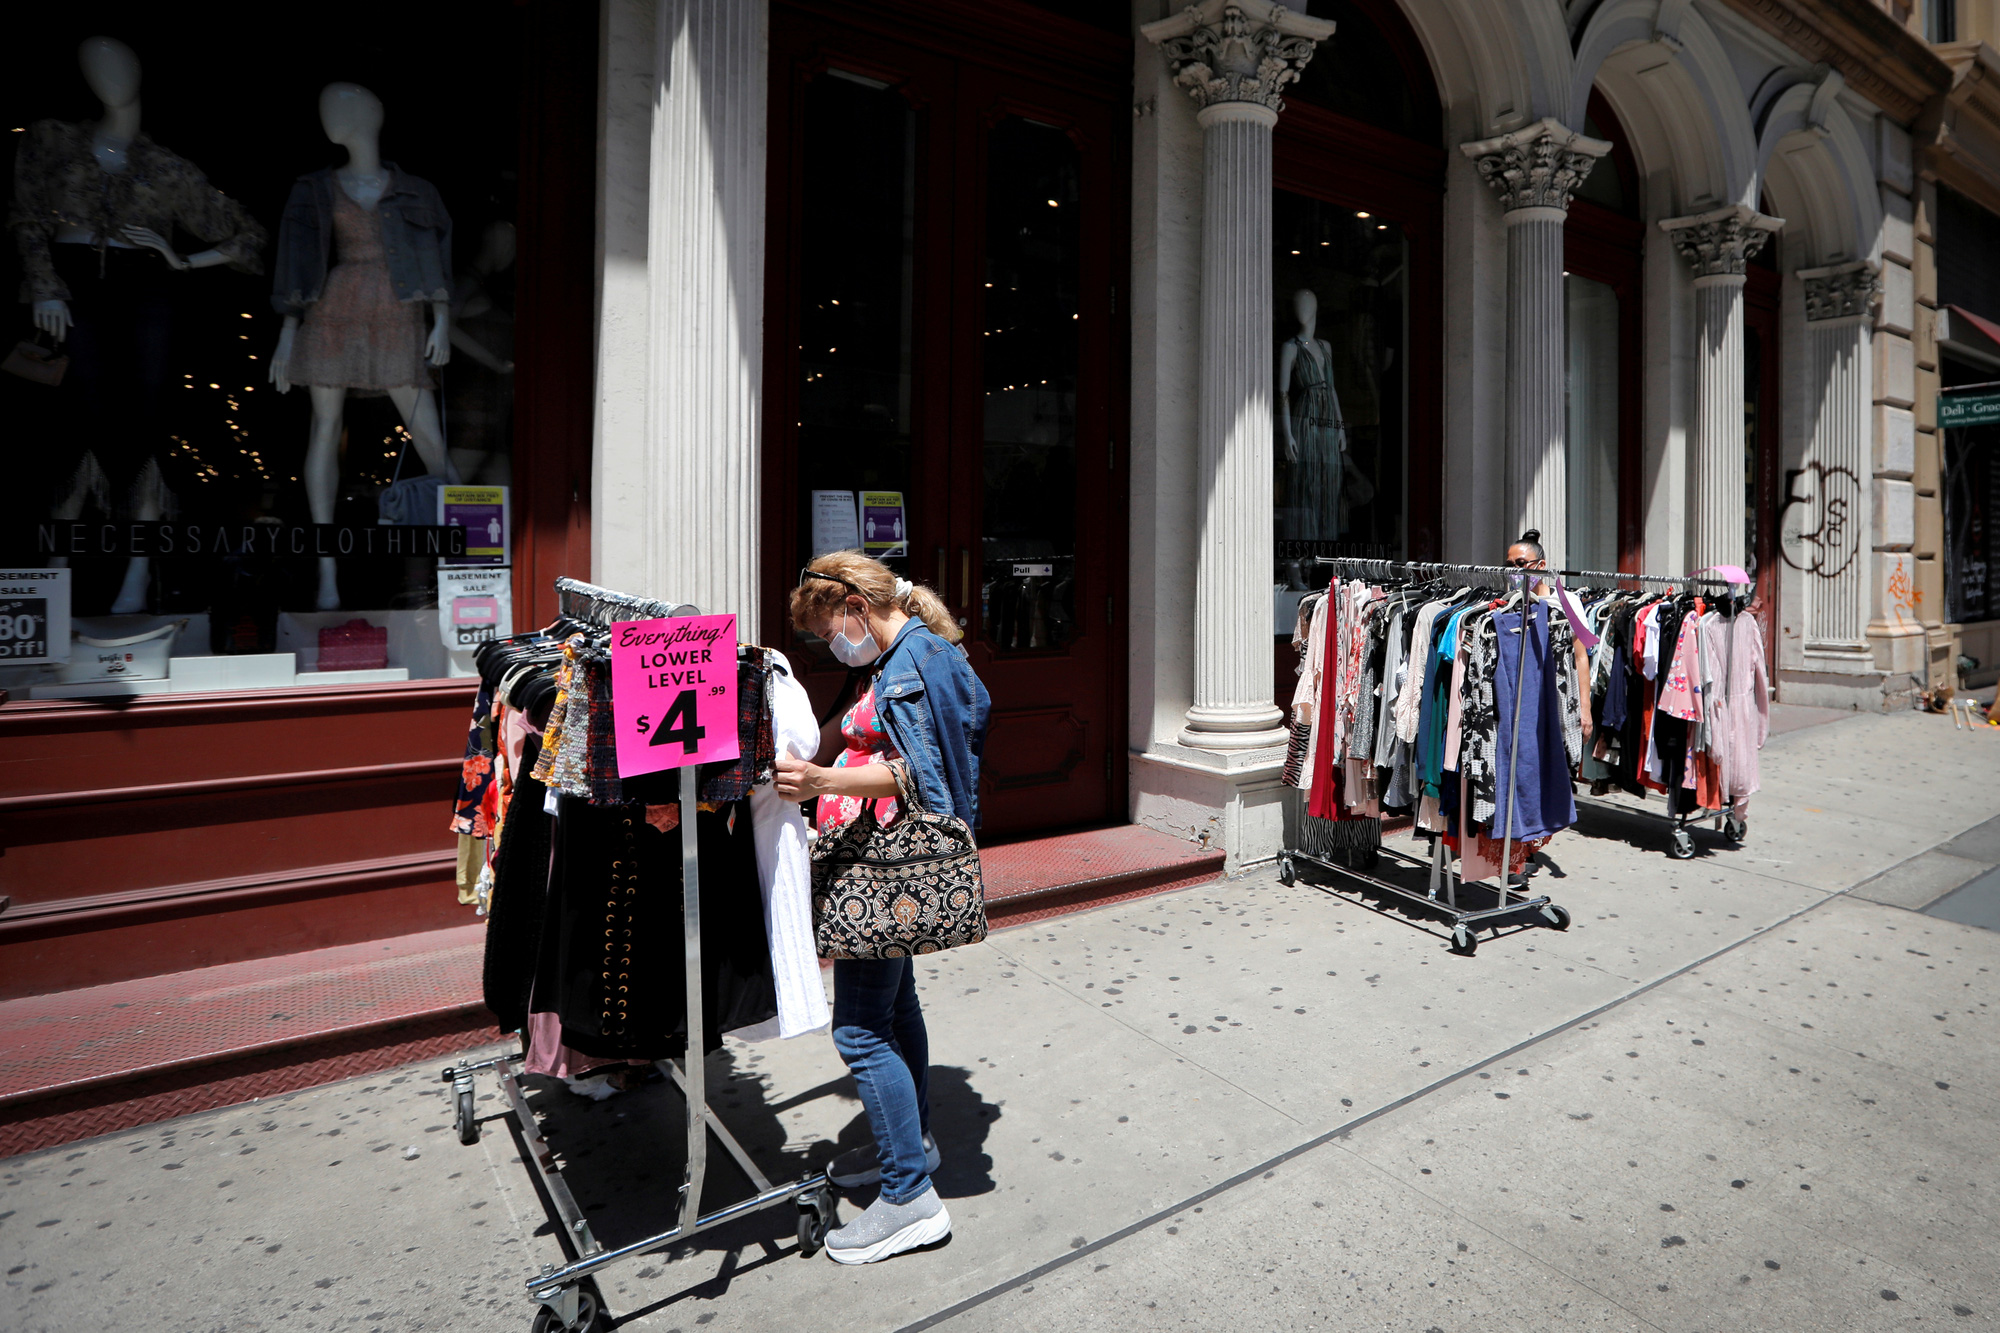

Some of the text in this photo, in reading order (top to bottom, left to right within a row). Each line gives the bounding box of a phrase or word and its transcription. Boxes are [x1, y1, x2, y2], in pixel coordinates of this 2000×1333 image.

[1941, 404, 1965, 417] Deli
[447, 572, 502, 581] BASEMENT
[1, 586, 37, 595] SALE
[462, 584, 487, 592] SALE
[620, 619, 733, 650] Everything!
[641, 649, 713, 669] LOWER
[648, 670, 706, 688] LEVEL
